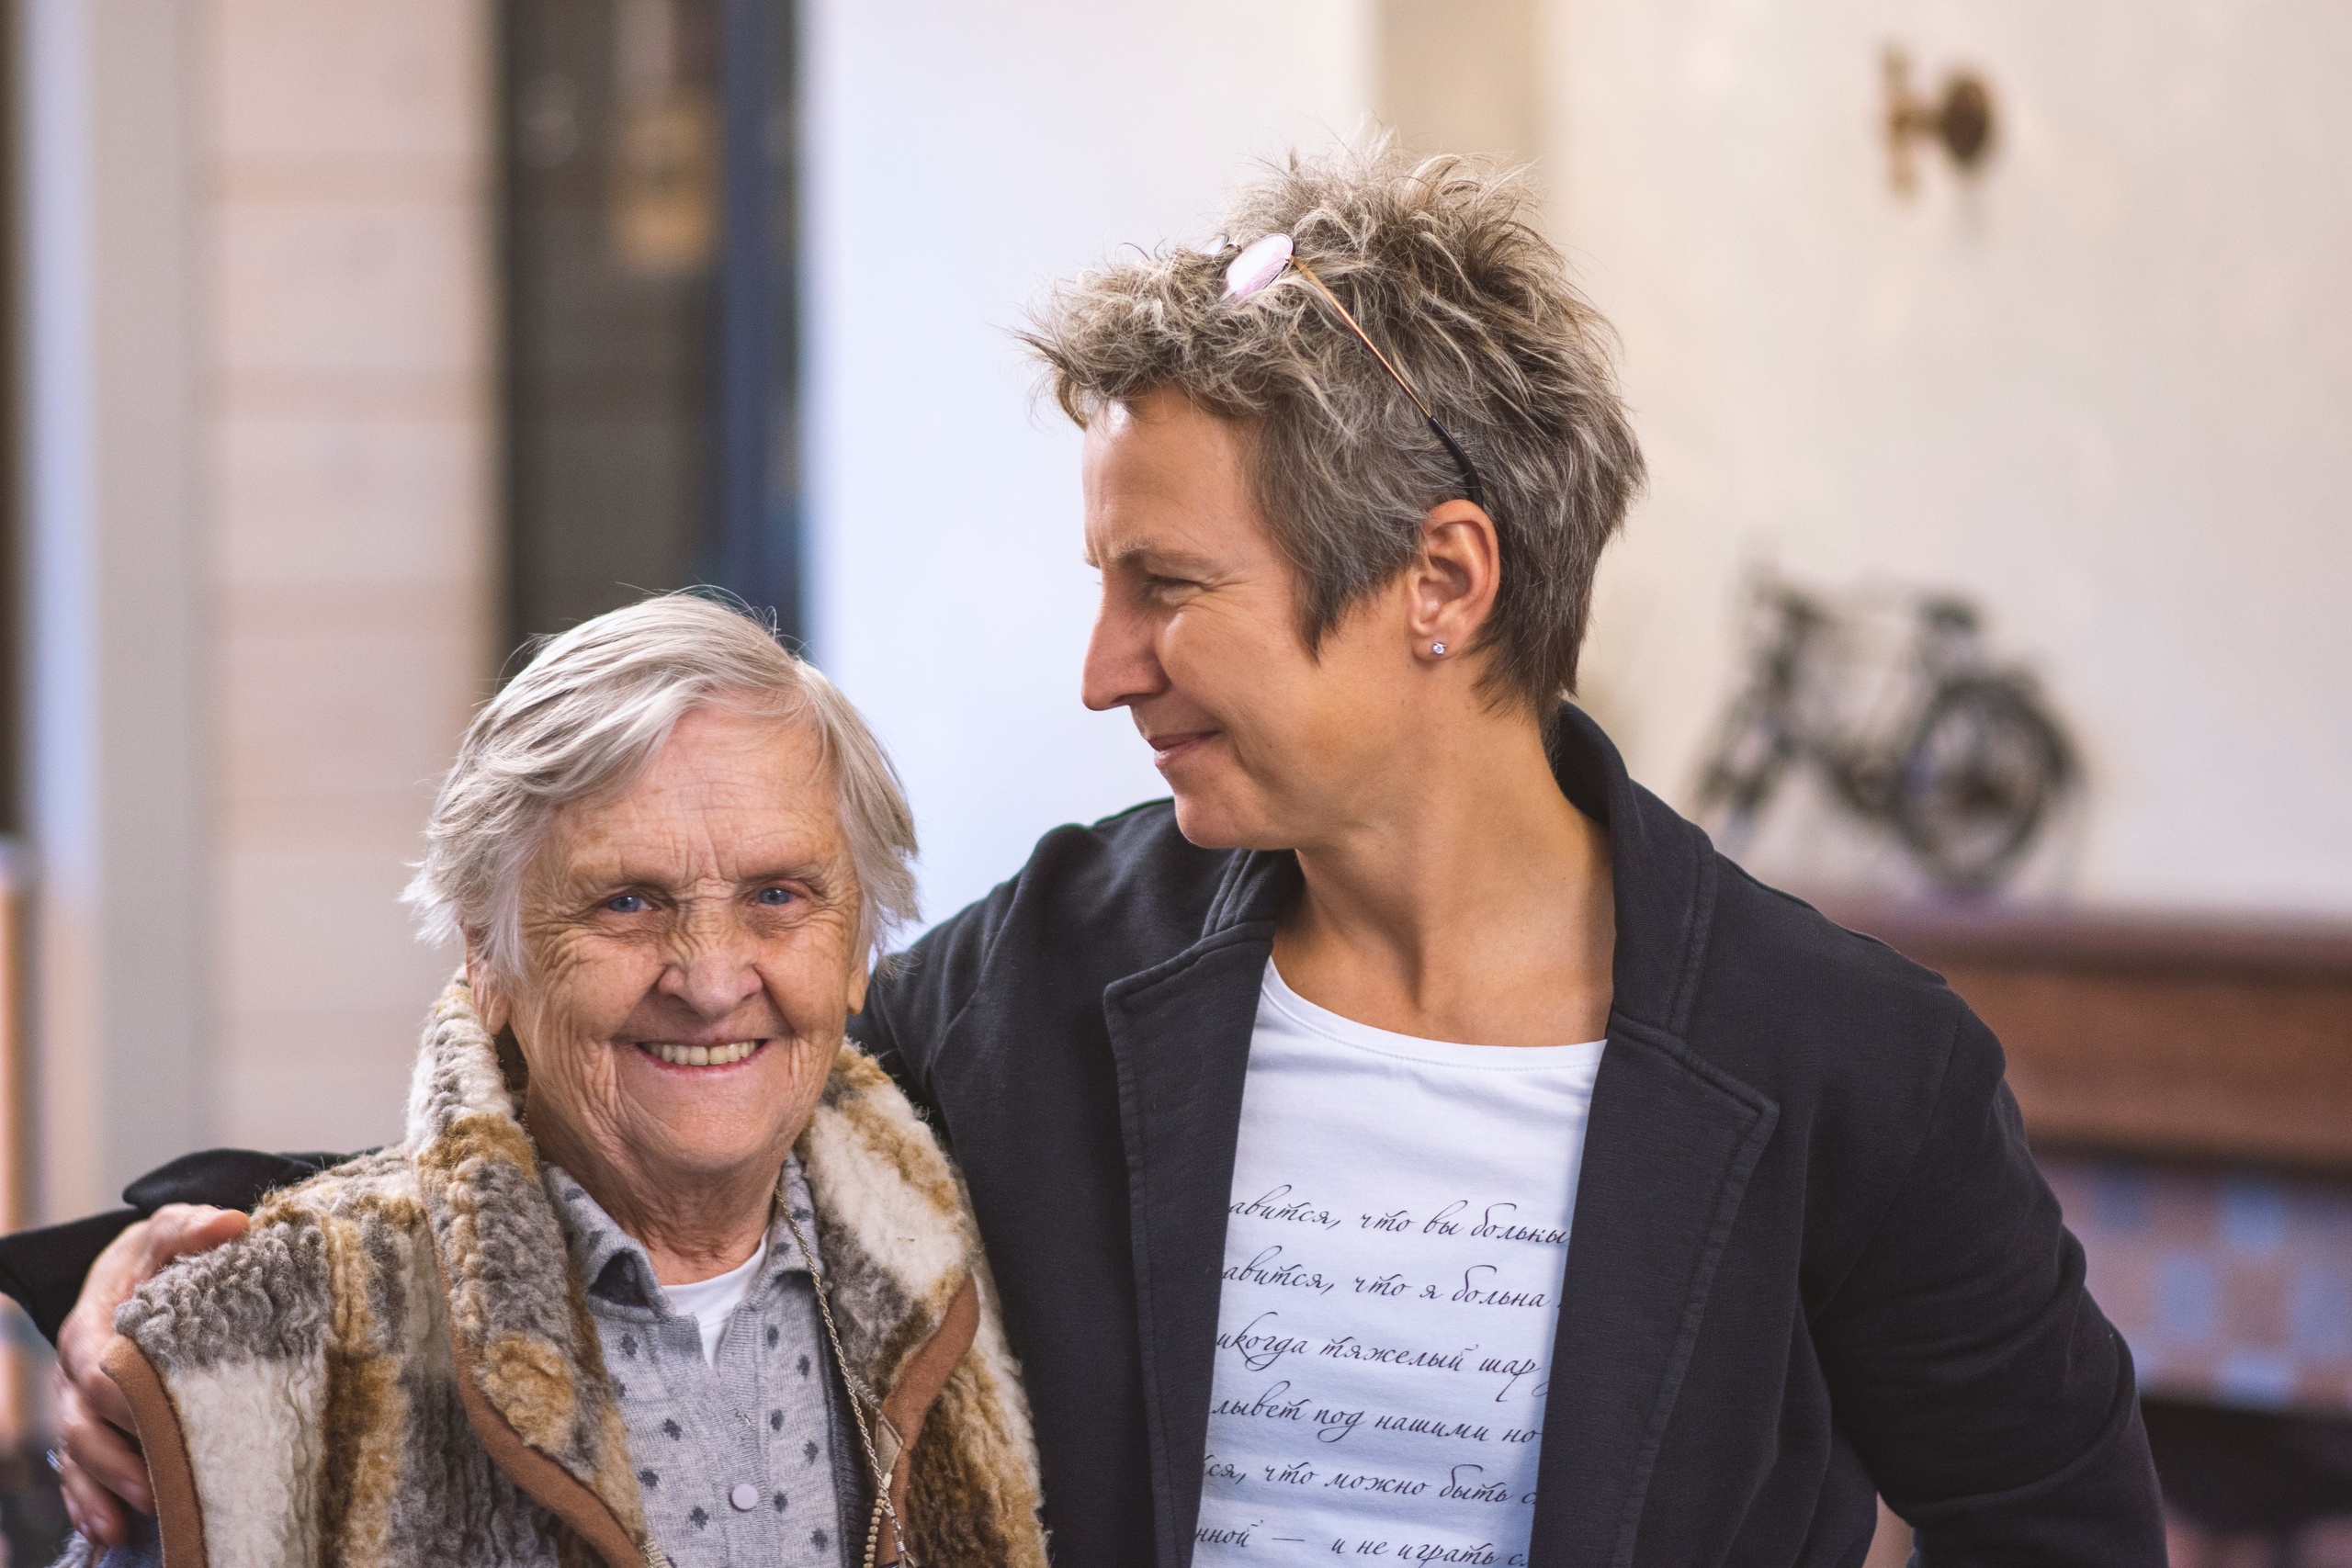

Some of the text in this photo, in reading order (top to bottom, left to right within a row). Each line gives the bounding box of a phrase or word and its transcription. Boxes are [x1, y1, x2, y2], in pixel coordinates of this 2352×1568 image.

[1229, 1184, 1569, 1244] авится, что вы больны
[1222, 1245, 1551, 1307] авится, что я больна
[1216, 1312, 1541, 1402] икогда тяжелый шар
[1210, 1381, 1542, 1443] лывет под нашими но
[1265, 1461, 1319, 1484] что
[1324, 1473, 1431, 1495] можно
[1439, 1463, 1514, 1502] быть
[1194, 1519, 1264, 1547] нной
[1331, 1539, 1347, 1555] и
[1356, 1540, 1389, 1556] не
[1397, 1542, 1501, 1568] играть
